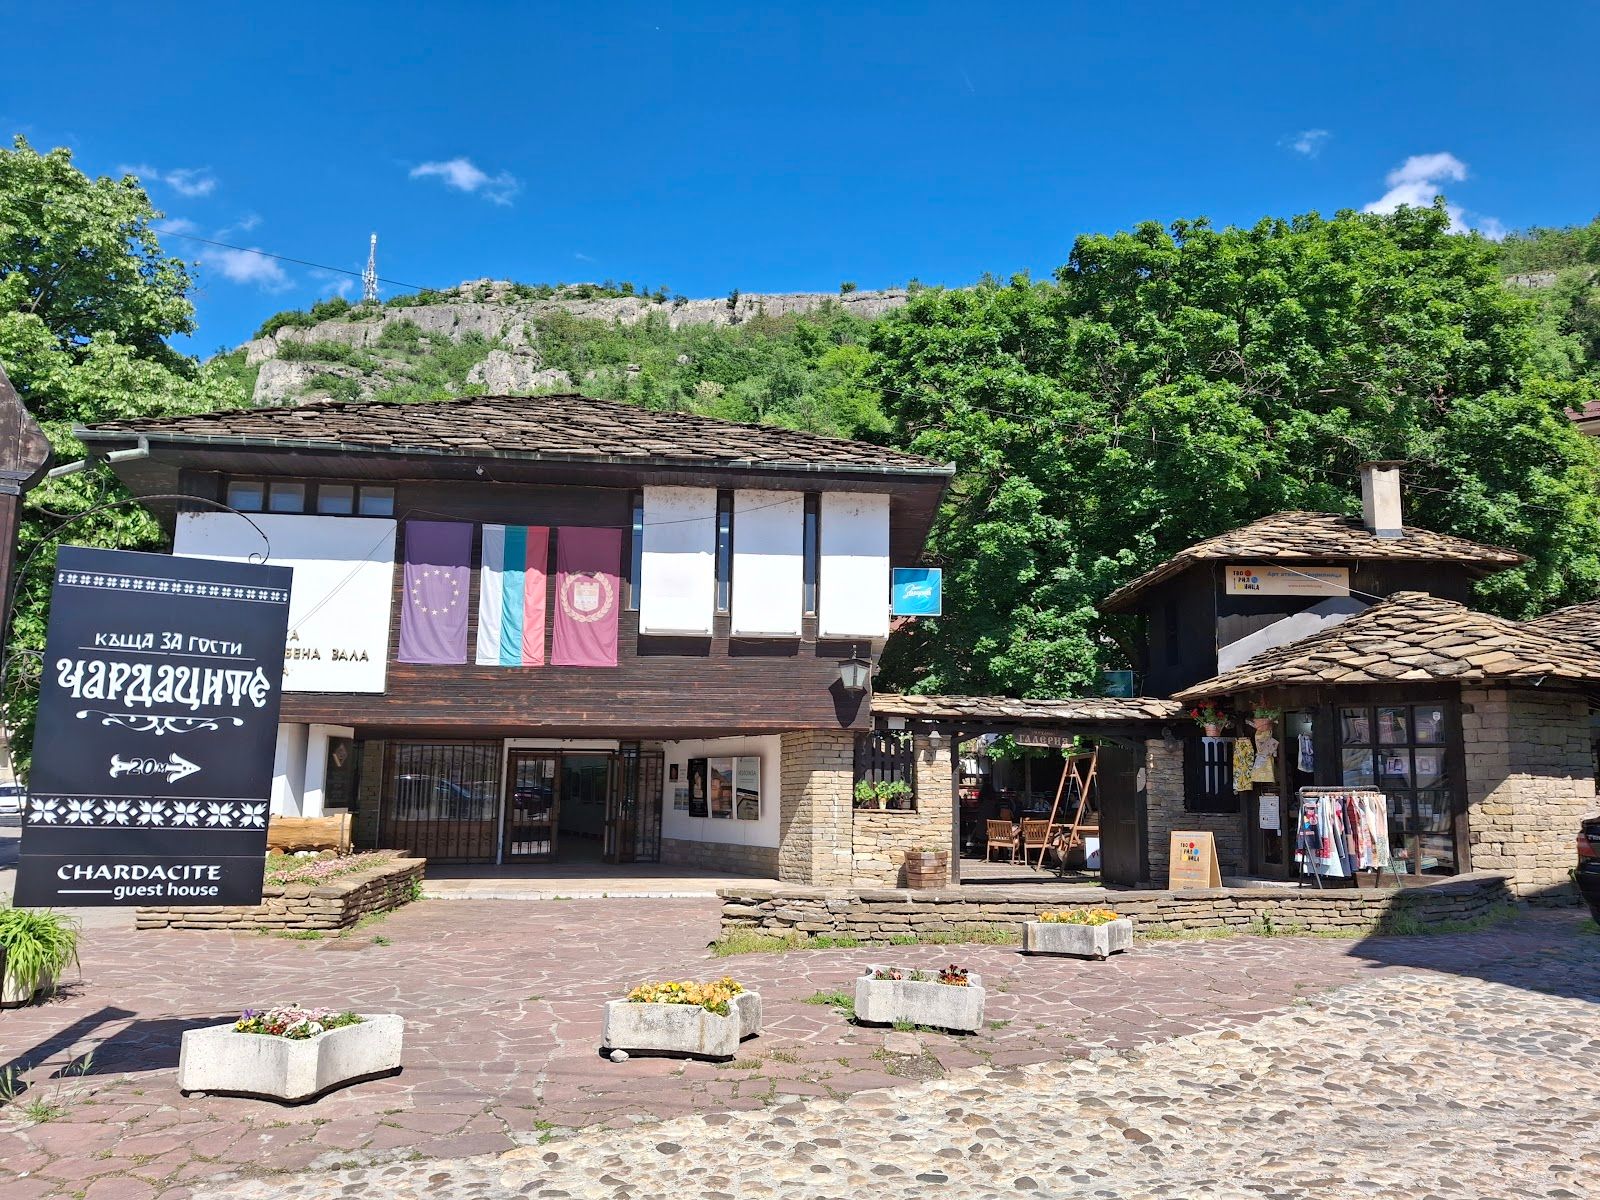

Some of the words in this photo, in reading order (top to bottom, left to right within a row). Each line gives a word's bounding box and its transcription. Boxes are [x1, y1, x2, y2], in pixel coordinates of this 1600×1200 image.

[95, 632, 154, 649] КЪЩА
[160, 631, 183, 650] ЗА
[188, 636, 243, 656] ГОСТИ
[331, 648, 369, 662] ЗАЛА
[56, 864, 222, 880] CHARDACITE
[113, 883, 164, 900] guest
[167, 882, 219, 896] house
